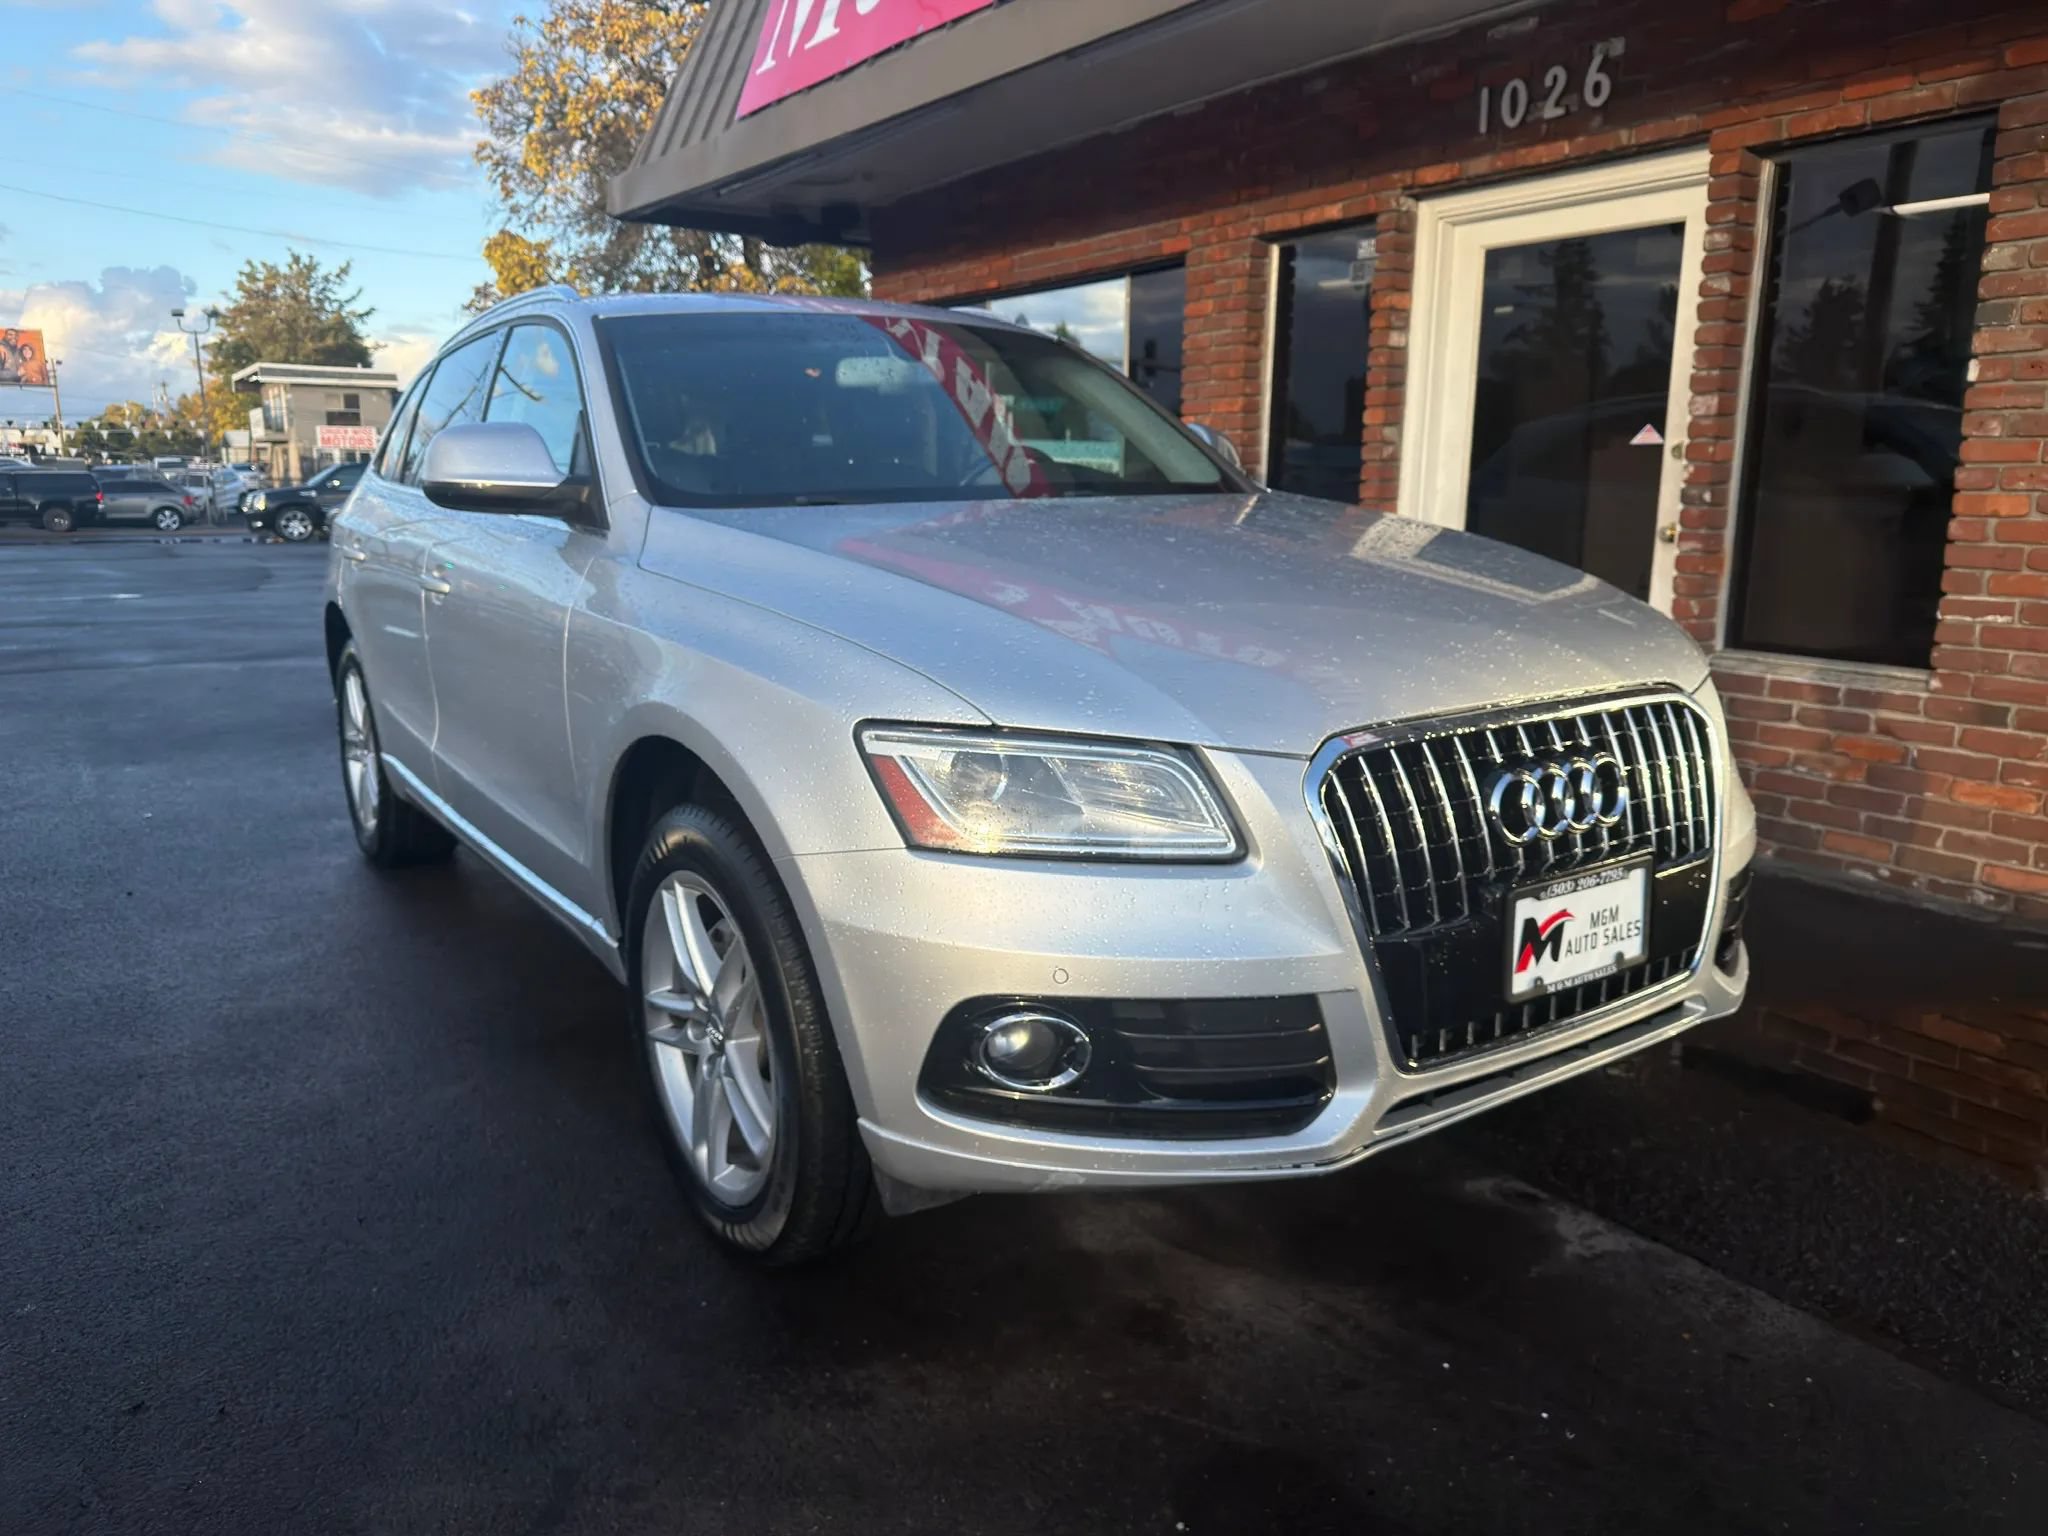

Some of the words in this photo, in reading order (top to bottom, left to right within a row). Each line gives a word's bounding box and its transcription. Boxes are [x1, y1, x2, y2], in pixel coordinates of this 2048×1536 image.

[1479, 48, 1612, 134] 1026
[1547, 880, 1576, 898] (503)
[1564, 932, 1598, 958] AUTO
[1602, 919, 1641, 946] SALES
